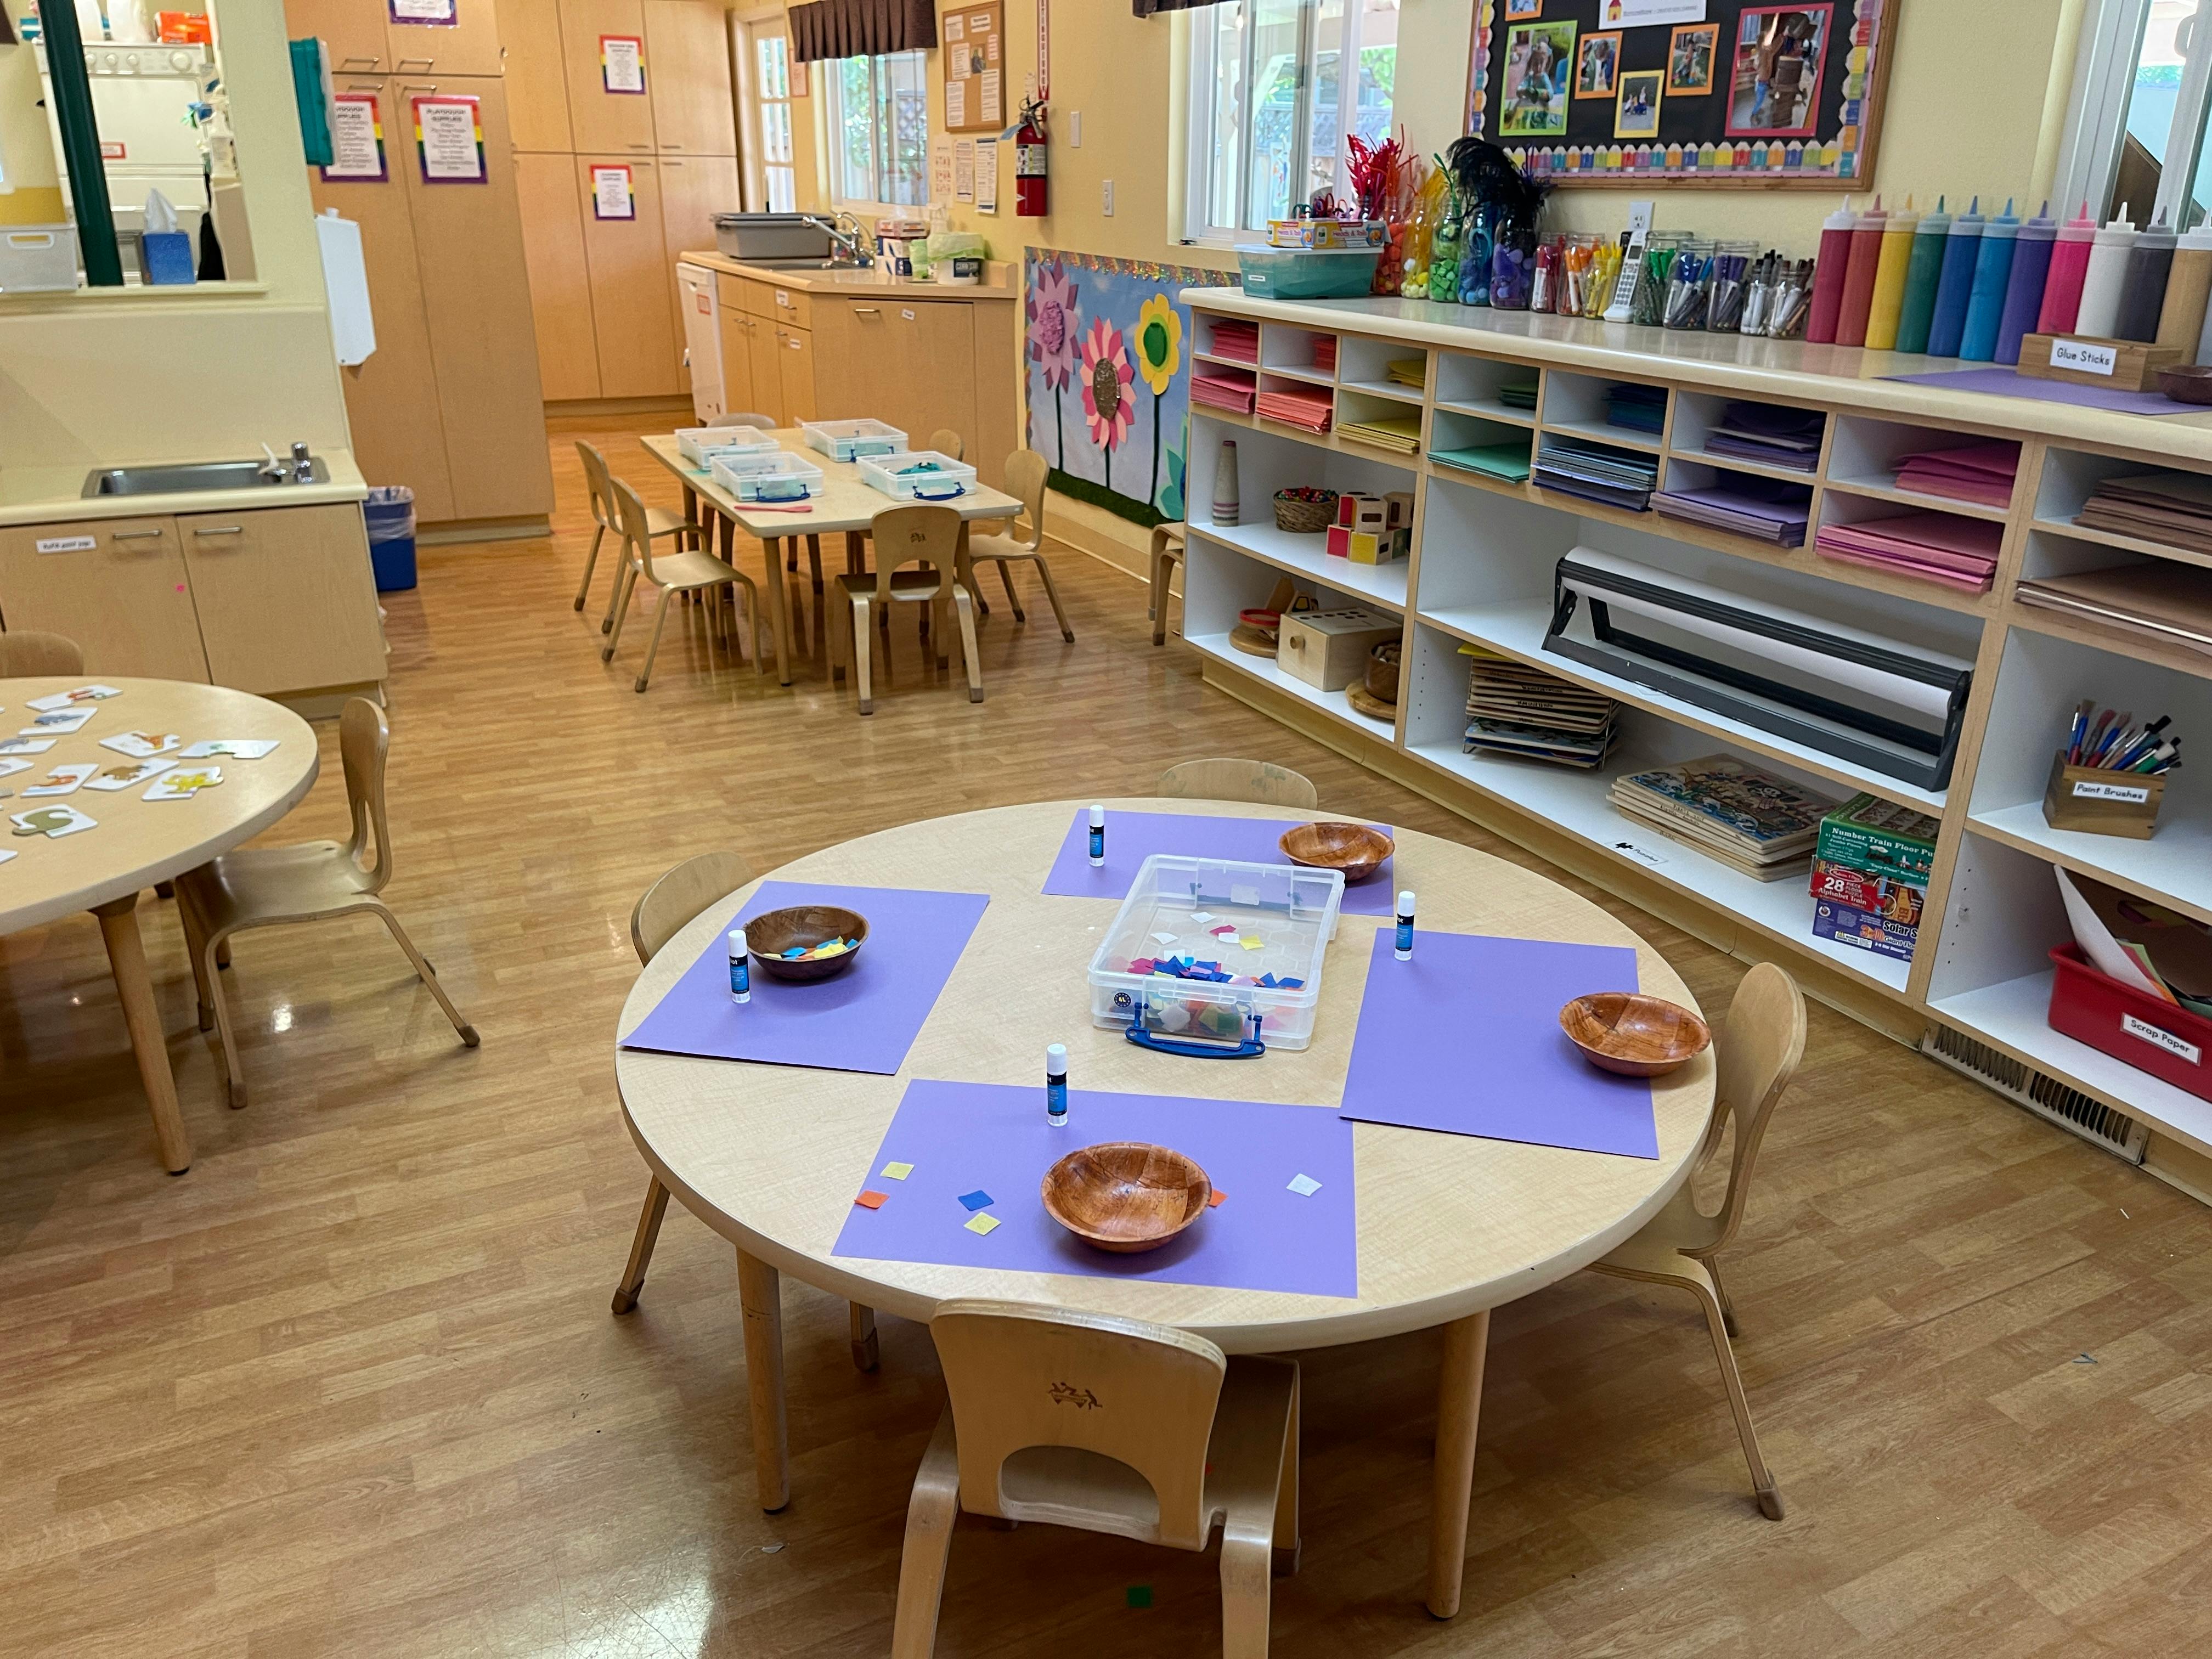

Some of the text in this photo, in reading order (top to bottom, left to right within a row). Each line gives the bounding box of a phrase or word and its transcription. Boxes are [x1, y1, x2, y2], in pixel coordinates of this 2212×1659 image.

[2057, 347, 2110, 365] Glue Sticks
[2077, 784, 2143, 799] Paint Brushes
[1832, 827, 1866, 841] Number
[1869, 836, 1892, 848] Train
[1894, 842, 1919, 854] Floor
[1825, 877, 1844, 892] 28
[1818, 888, 1867, 905] Alphabet Train
[1884, 921, 1910, 935] Solar
[1885, 936, 1903, 946] Giant
[2130, 1019, 2191, 1053] Scrap Paper
